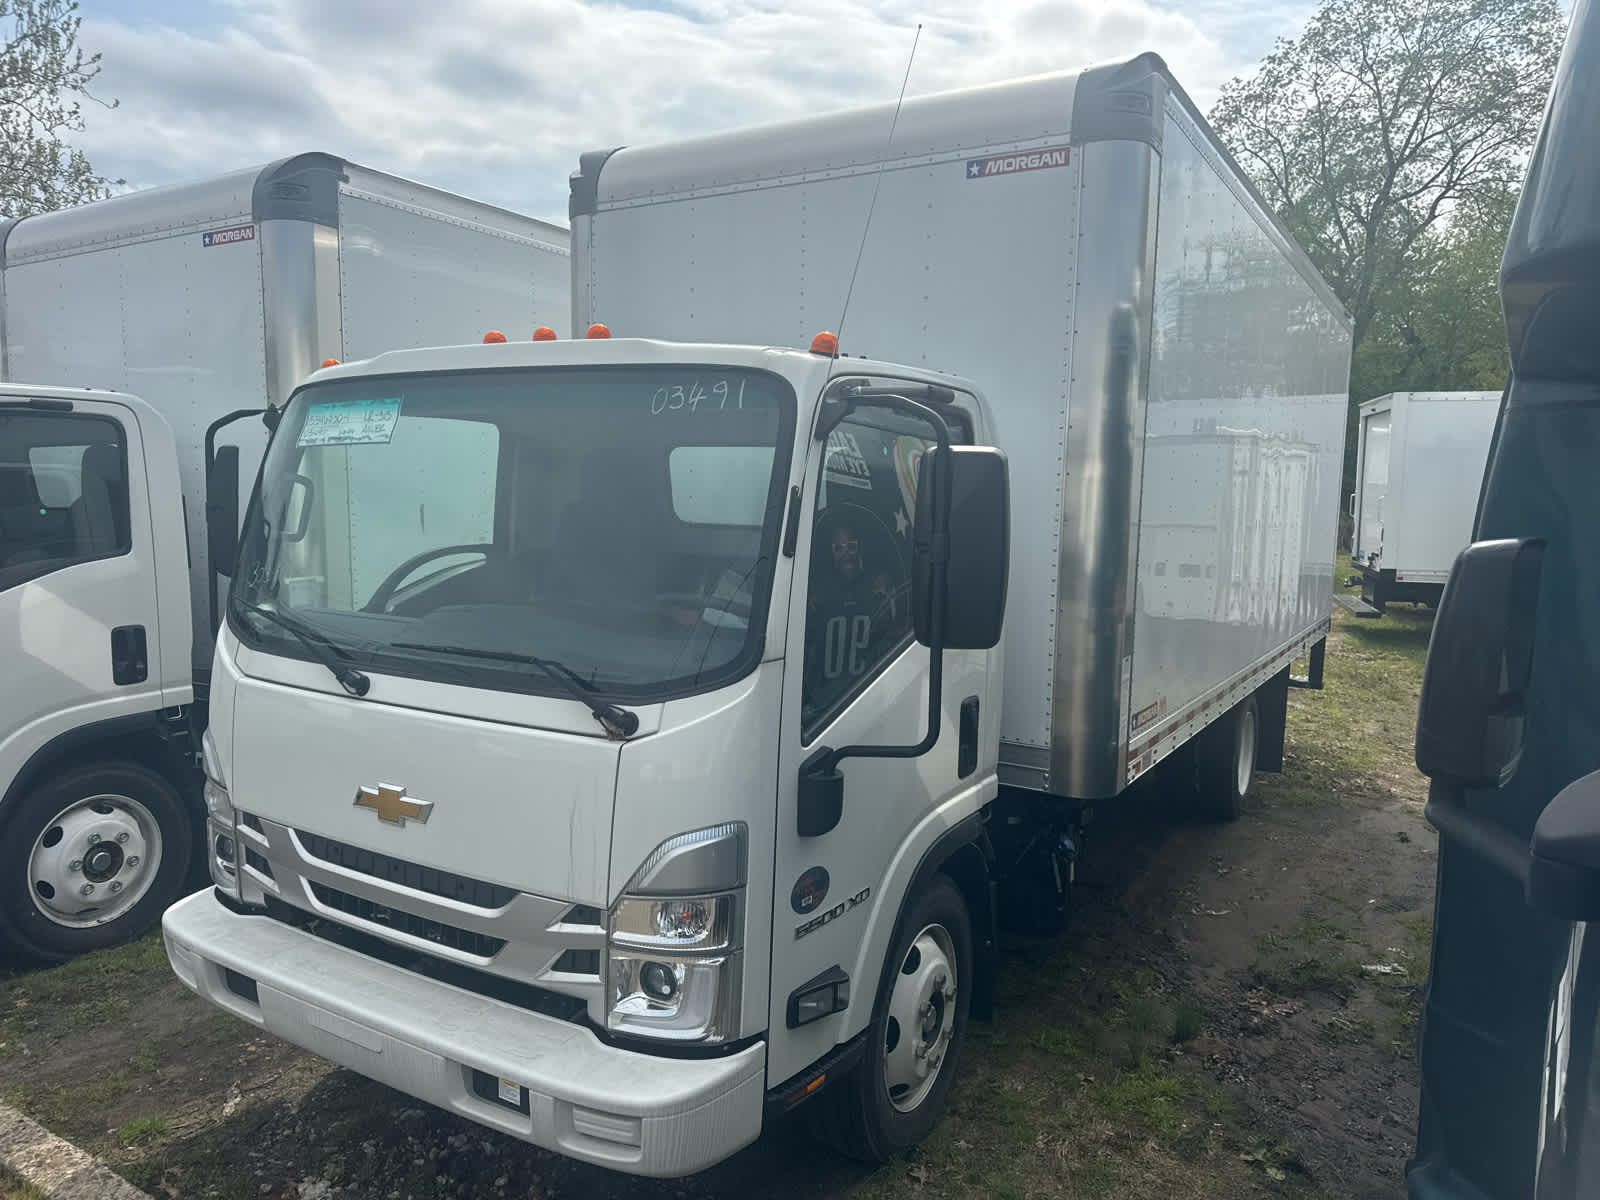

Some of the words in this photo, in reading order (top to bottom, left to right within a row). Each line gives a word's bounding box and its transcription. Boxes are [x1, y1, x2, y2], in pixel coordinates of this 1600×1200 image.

[984, 151, 1066, 175] MORGAN
[212, 228, 253, 244] MORGAN
[651, 378, 747, 415] 03491
[847, 887, 870, 912] XD
